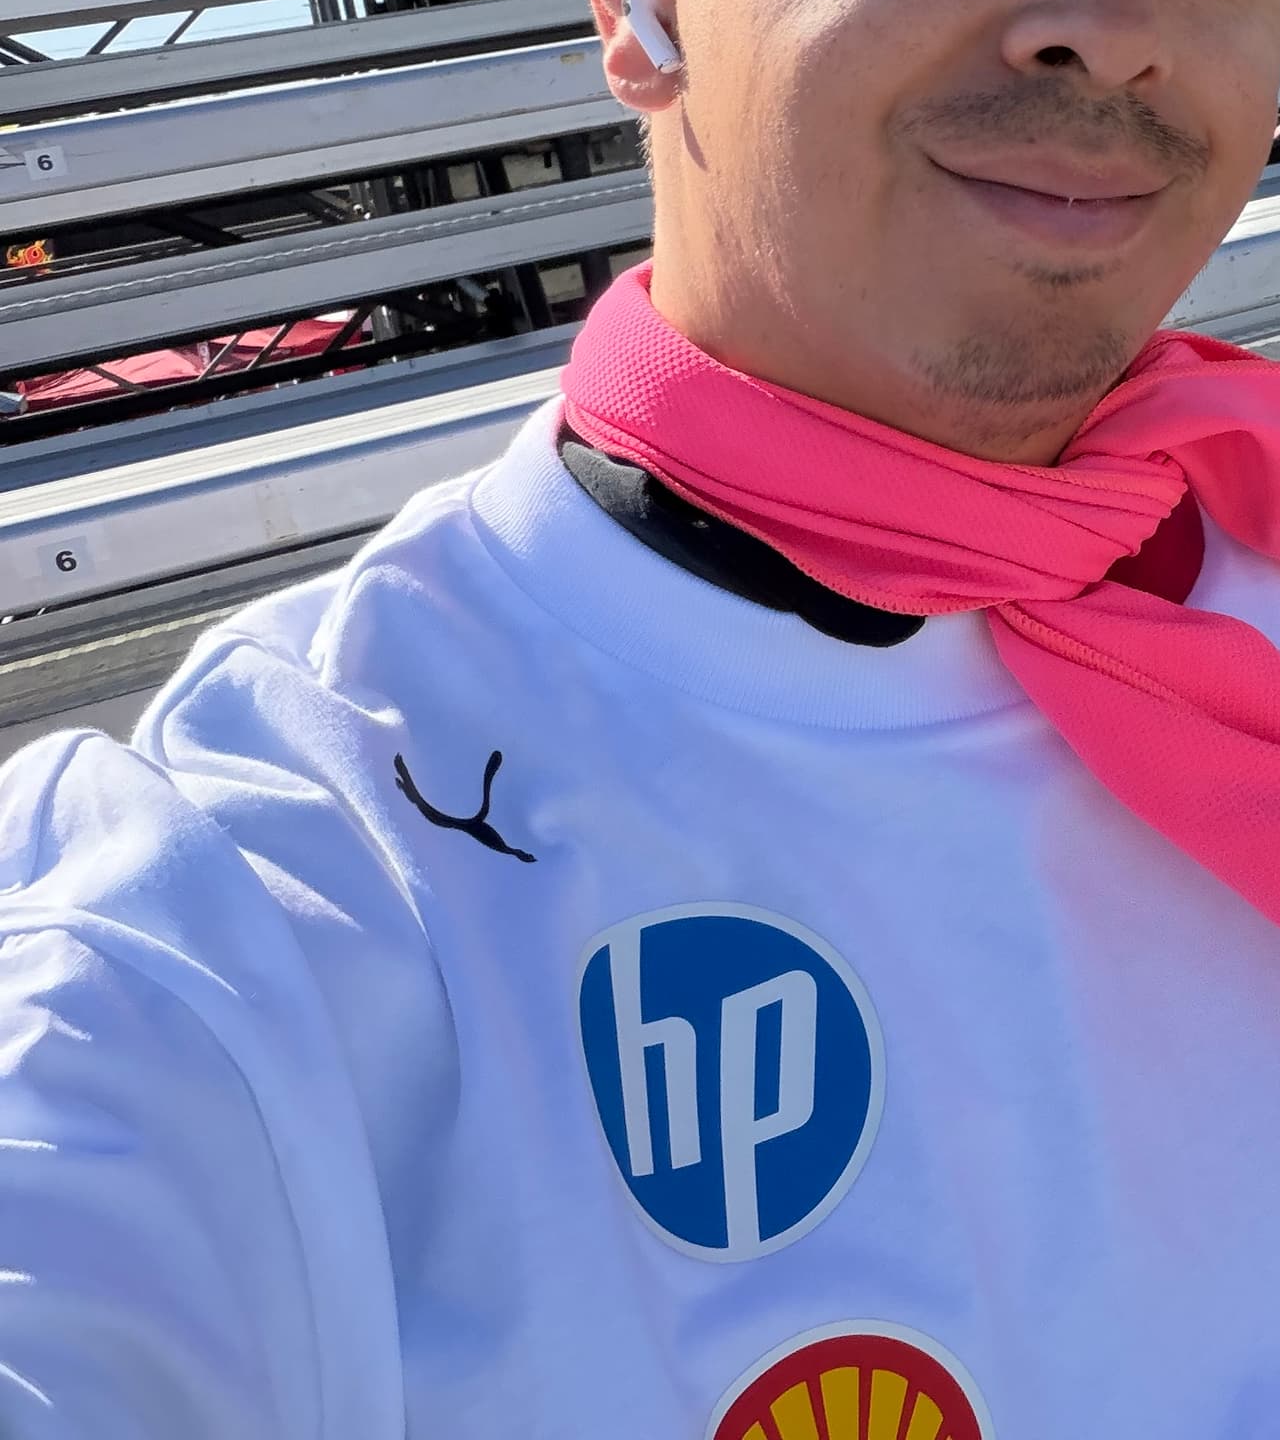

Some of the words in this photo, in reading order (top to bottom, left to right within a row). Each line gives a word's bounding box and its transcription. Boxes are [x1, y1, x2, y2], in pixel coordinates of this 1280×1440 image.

[37, 154, 54, 171] 6
[55, 550, 78, 572] 6
[600, 912, 822, 1255] hp
